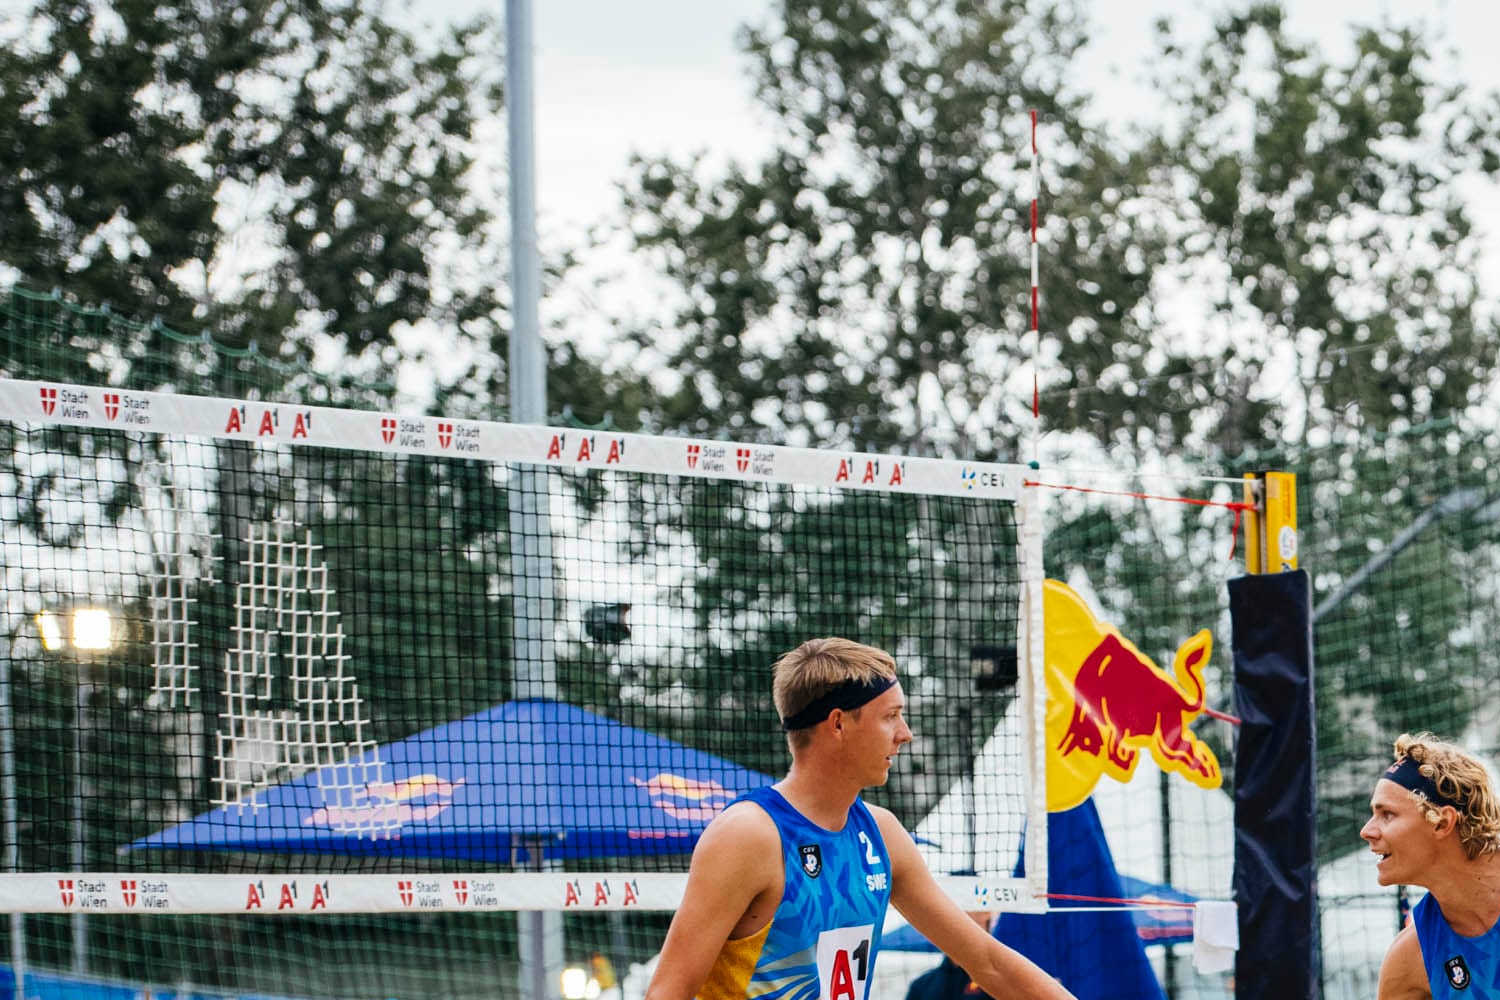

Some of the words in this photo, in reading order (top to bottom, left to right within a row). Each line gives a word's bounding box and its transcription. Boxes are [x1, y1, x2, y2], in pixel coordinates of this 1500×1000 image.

[61, 389, 88, 403] Stadt
[124, 395, 150, 410] Stadt
[61, 405, 89, 420] Wien
[124, 410, 150, 425] Wien
[225, 405, 246, 433] A1
[258, 408, 279, 436] A1
[292, 411, 312, 439] A1
[400, 420, 425, 433] Stadt
[456, 425, 480, 439] Stadt
[400, 435, 425, 448] Wien
[455, 440, 480, 452] Wien
[547, 433, 565, 460] A1
[577, 436, 595, 462] A1
[606, 438, 625, 464] A1
[703, 446, 726, 458] Stadt
[753, 450, 775, 462] Stadt
[702, 460, 725, 472] Wien
[752, 464, 774, 476] Wien
[858, 831, 880, 864] 2
[77, 880, 106, 893] Stadt
[141, 880, 169, 893] Stadt
[416, 881, 440, 893] Stadt
[470, 880, 498, 892] Stadt
[866, 873, 887, 891] SWE
[245, 880, 265, 910] A1
[278, 880, 298, 910] A1
[311, 880, 330, 910] A1
[564, 878, 582, 907] A1
[594, 878, 612, 907] A1
[623, 878, 640, 907] A1
[994, 887, 1018, 901] CEV
[80, 895, 107, 908] Wien
[142, 896, 169, 909] Wien
[418, 896, 443, 908] Wien
[472, 894, 498, 906] Wien
